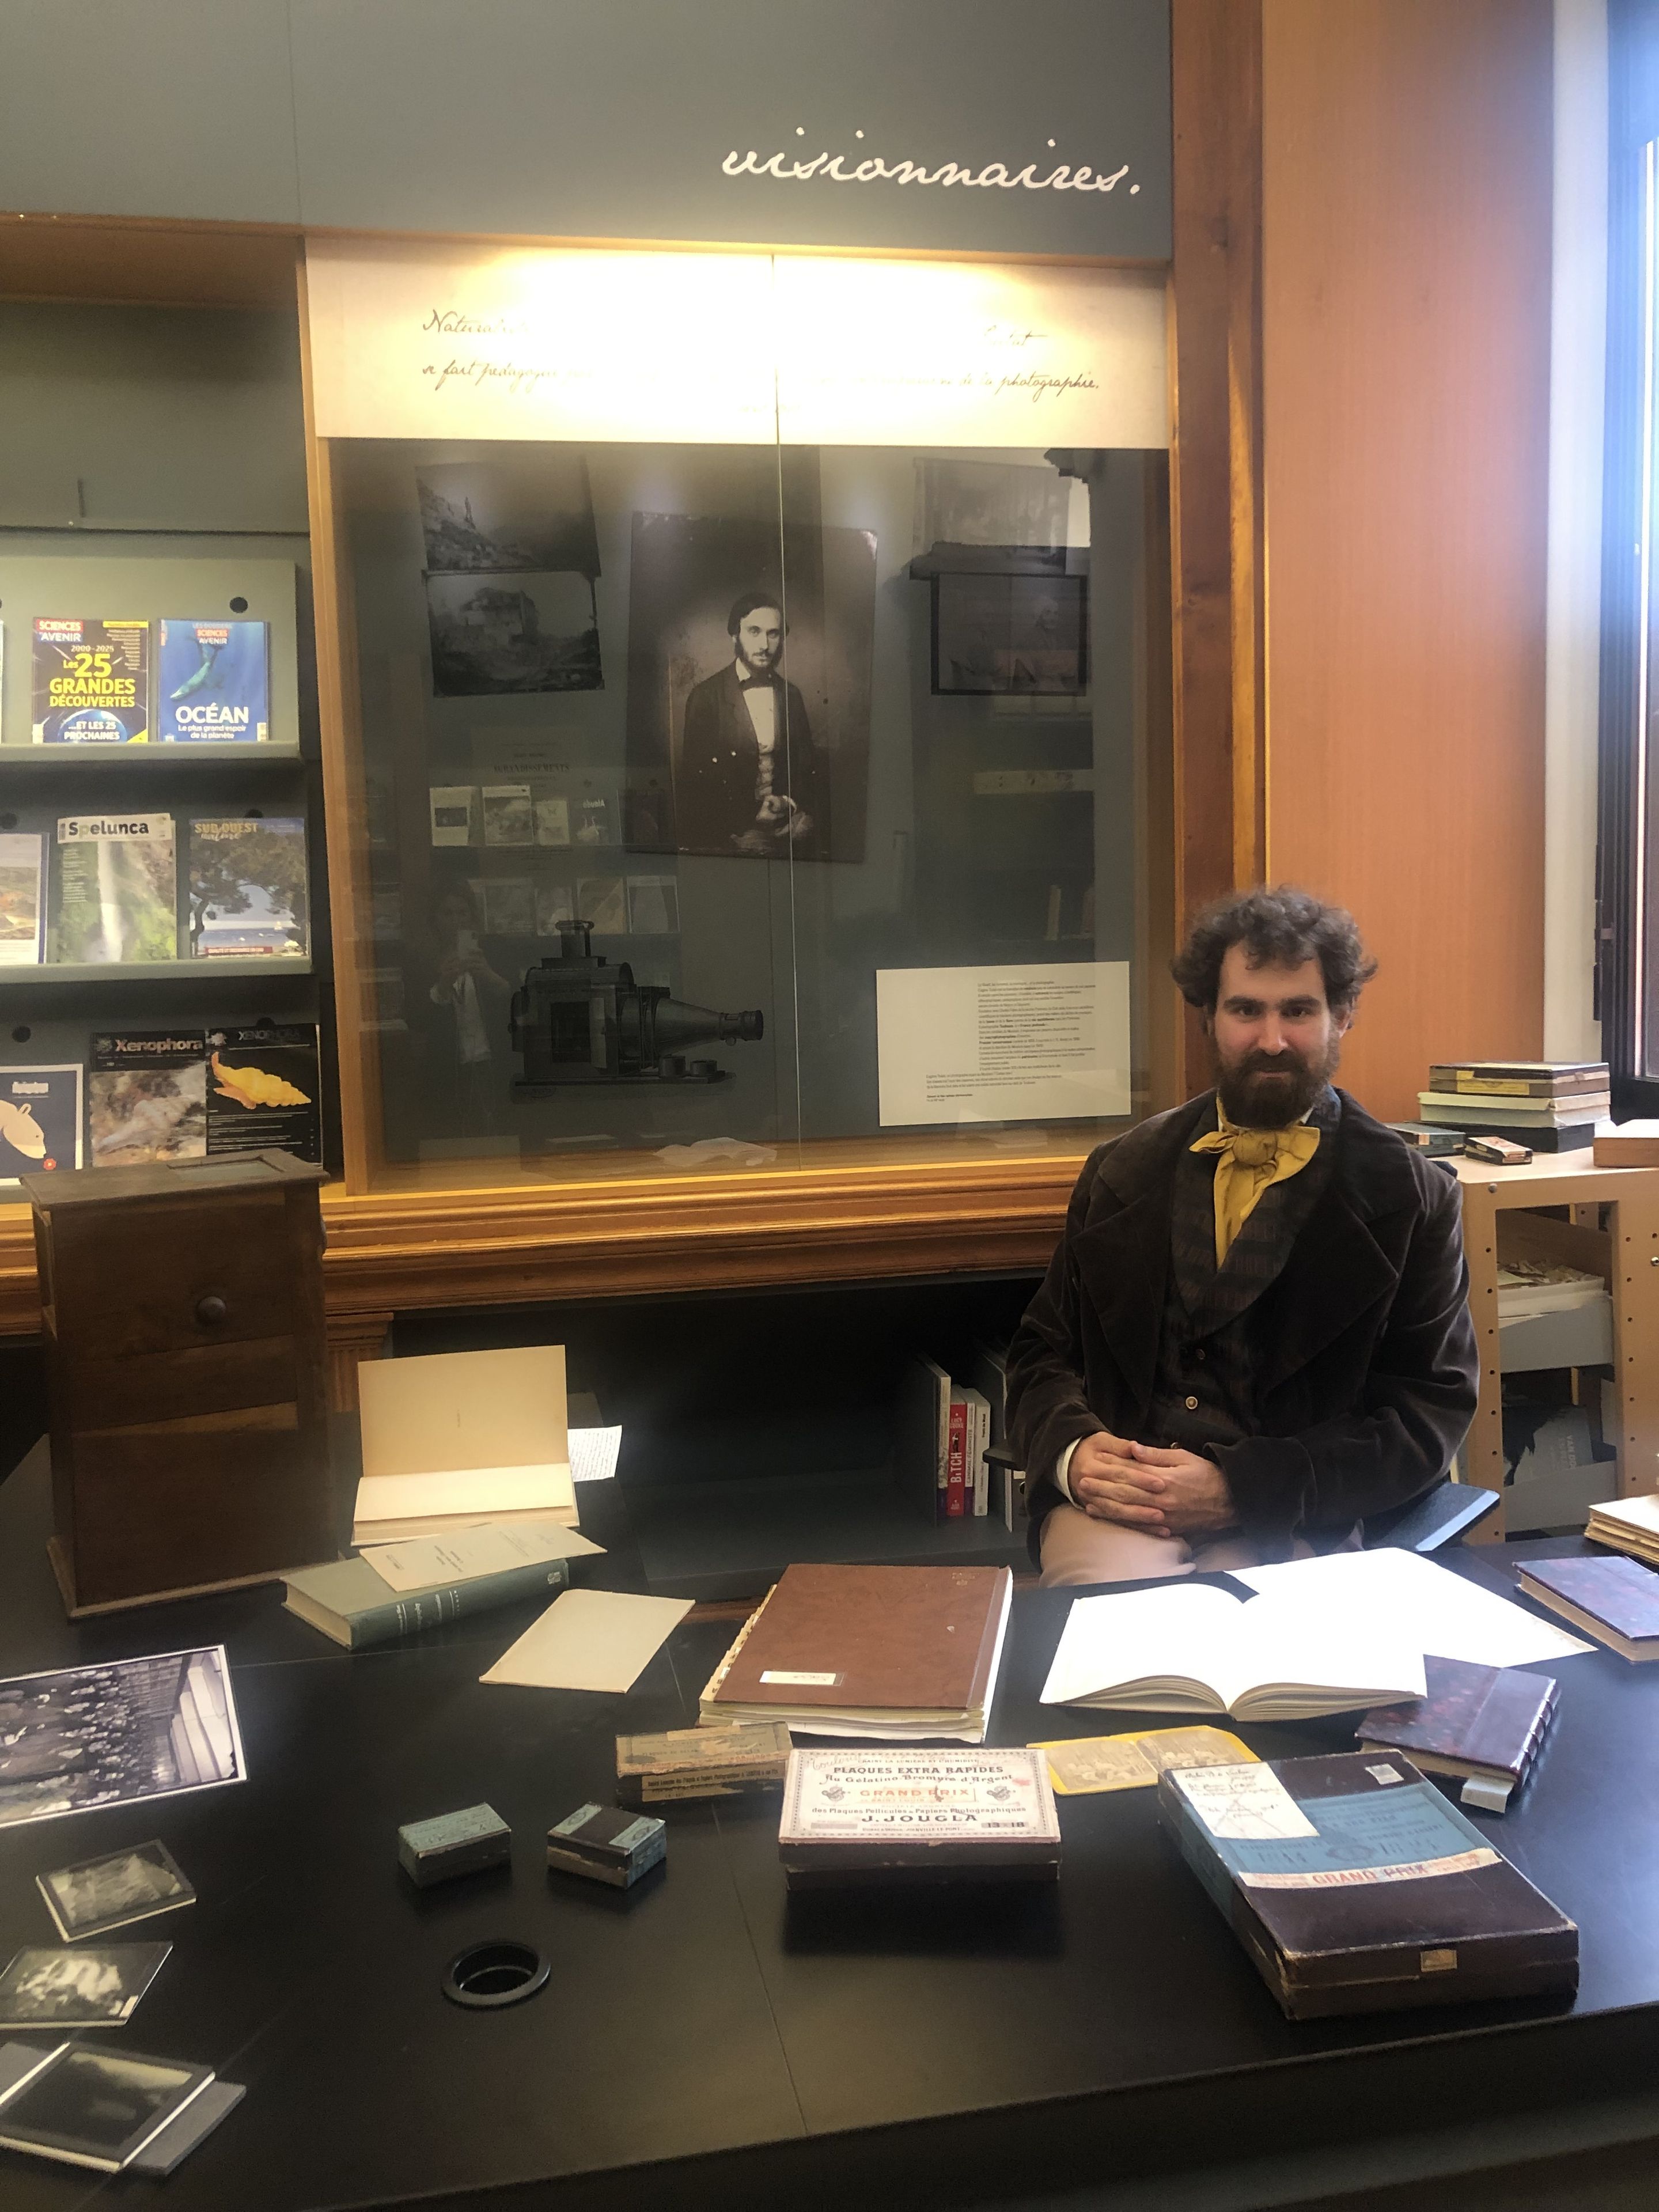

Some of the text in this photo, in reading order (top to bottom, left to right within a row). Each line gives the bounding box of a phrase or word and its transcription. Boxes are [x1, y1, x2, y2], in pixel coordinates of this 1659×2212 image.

[721, 127, 1141, 195] visionnaires.
[995, 370, 1099, 403] photographie.
[39, 622, 81, 631] SCIENCES
[40, 632, 81, 642] AVENIR
[63, 660, 79, 669] Les
[74, 653, 112, 678] 25
[50, 678, 136, 695] GRANDES
[50, 694, 135, 707] DÉCOUVERTES
[175, 702, 249, 724] OCÉAN
[88, 721, 104, 730] LES
[105, 721, 116, 730] 25
[188, 725, 203, 733] plus
[203, 725, 225, 733] grand
[225, 725, 247, 733] espoir
[63, 731, 120, 740] PROCHAINES
[207, 732, 235, 740] planète
[68, 820, 149, 838] Spelunca
[195, 823, 218, 834] SUD
[221, 822, 258, 833] OUEST
[115, 1038, 203, 1053] Xenophora
[1312, 1870, 1377, 1884] GRAND
[1384, 1863, 1429, 1878] PRIX
